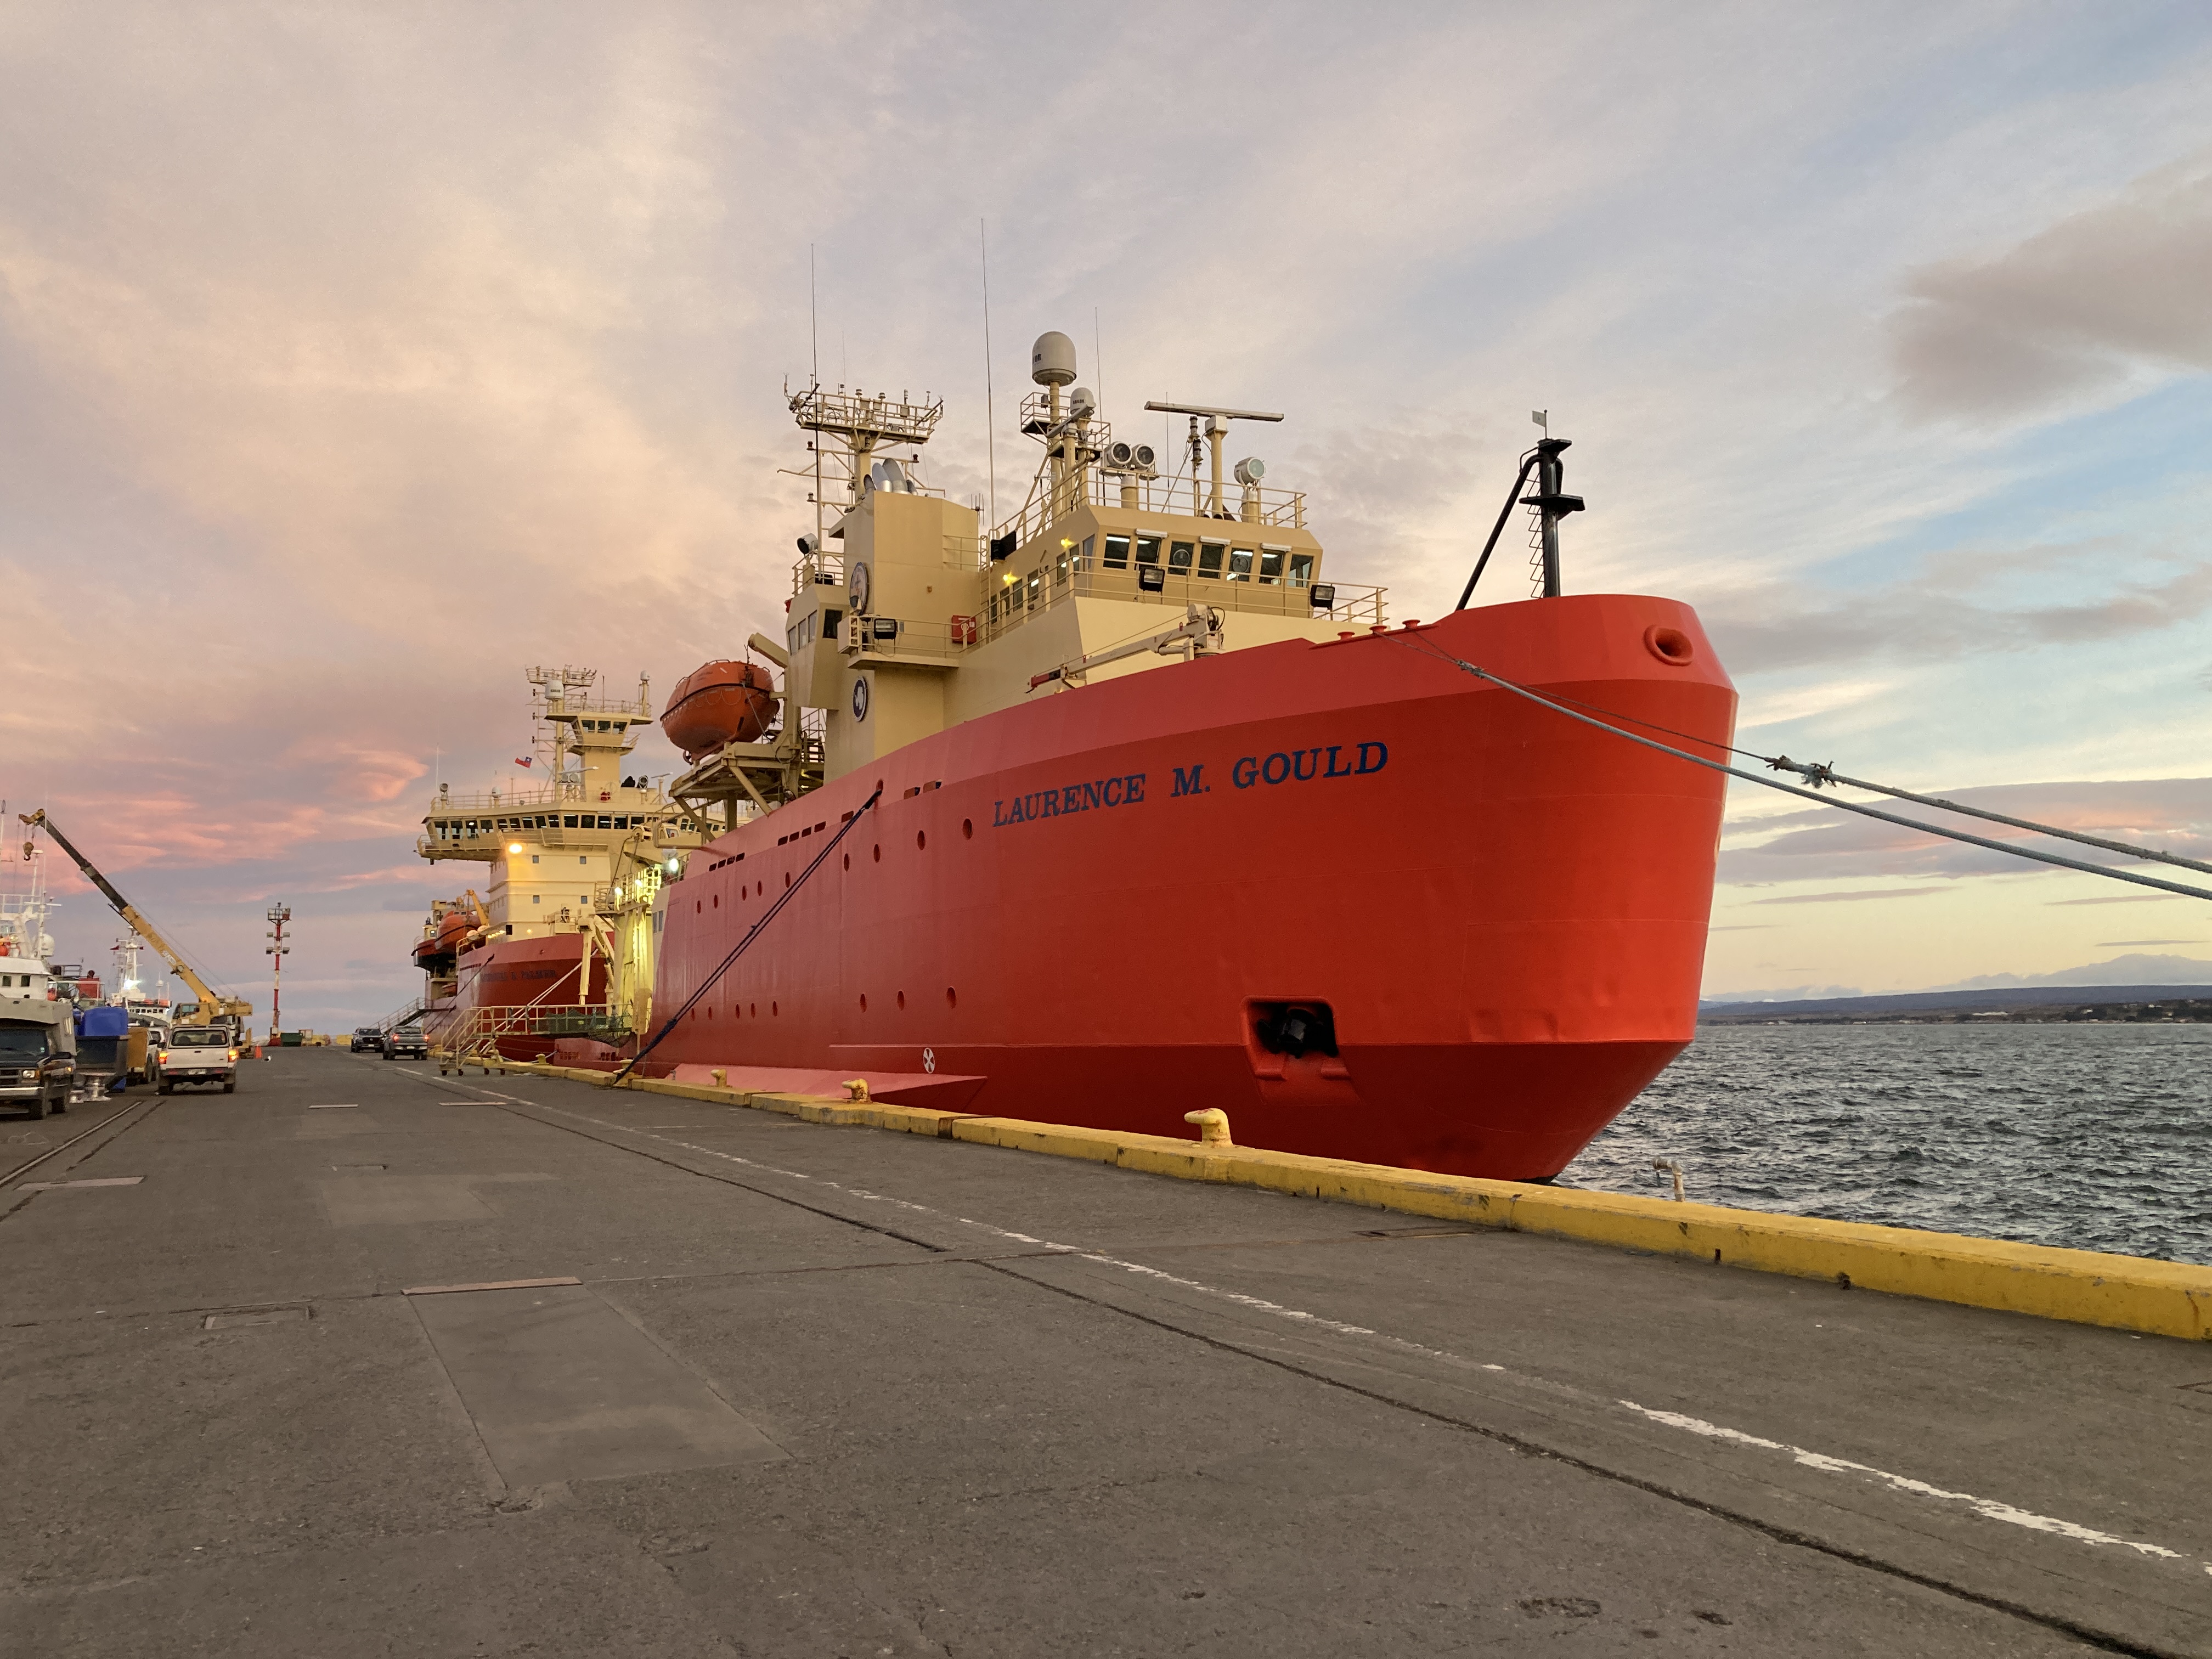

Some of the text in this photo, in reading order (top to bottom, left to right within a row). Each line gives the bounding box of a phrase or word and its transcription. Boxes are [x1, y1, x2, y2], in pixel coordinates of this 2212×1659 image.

[992, 741, 1389, 827] LAURENCE M. GOULD
